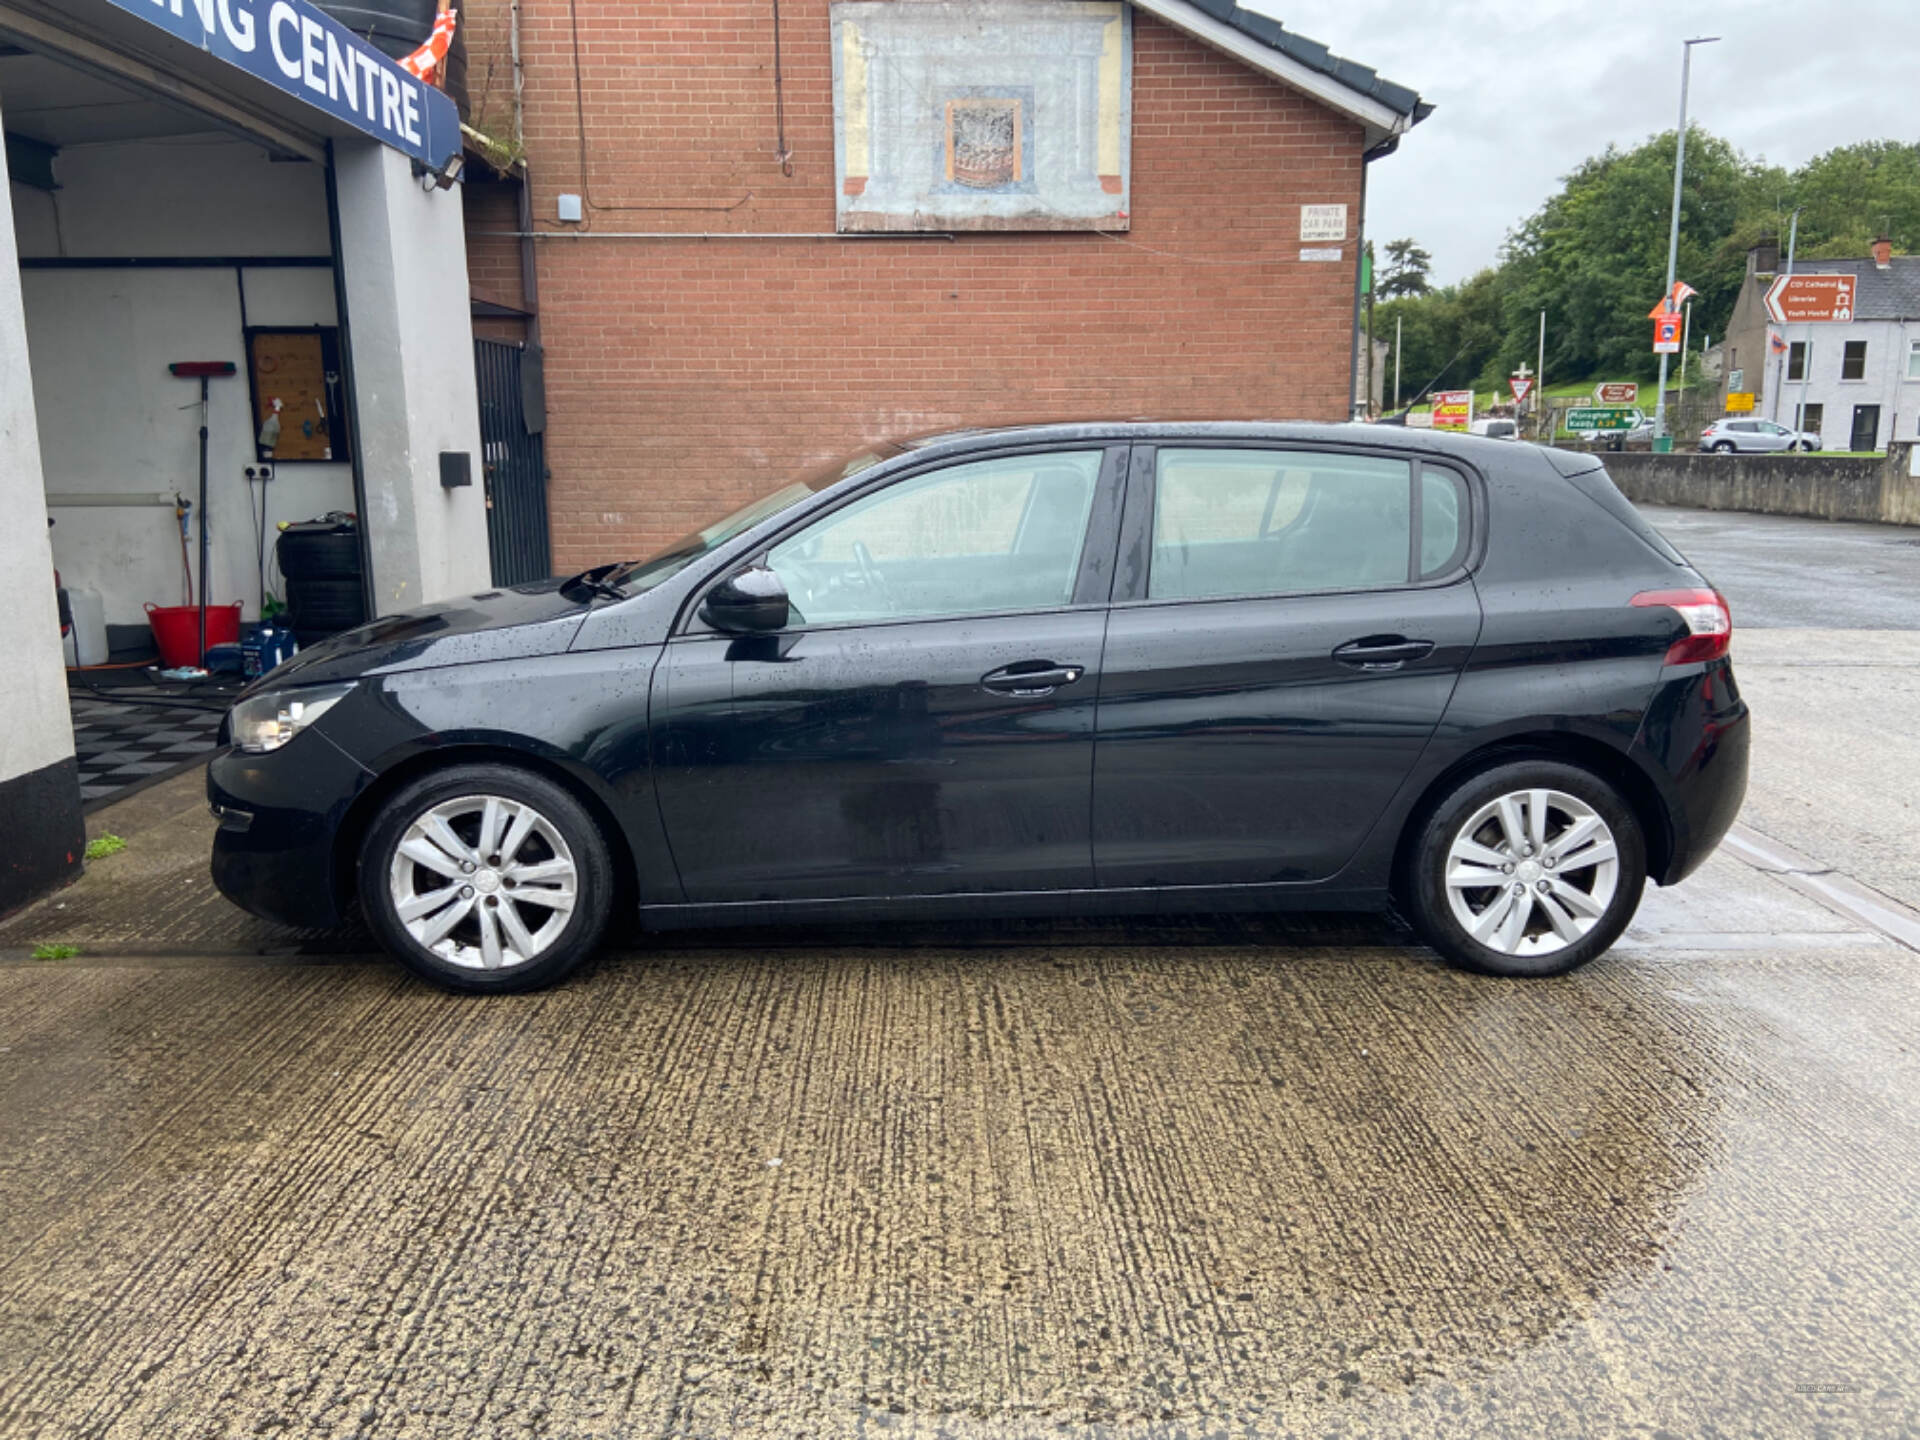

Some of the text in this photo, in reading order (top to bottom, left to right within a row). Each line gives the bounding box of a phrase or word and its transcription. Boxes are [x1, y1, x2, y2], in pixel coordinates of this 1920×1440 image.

[153, 0, 422, 147] NG CENTRE
[1307, 207, 1341, 217] PRIVATE
[1303, 219, 1343, 229] CAR PARK
[1805, 280, 1836, 288] Cathedral
[1570, 411, 1611, 419] Monaghan
